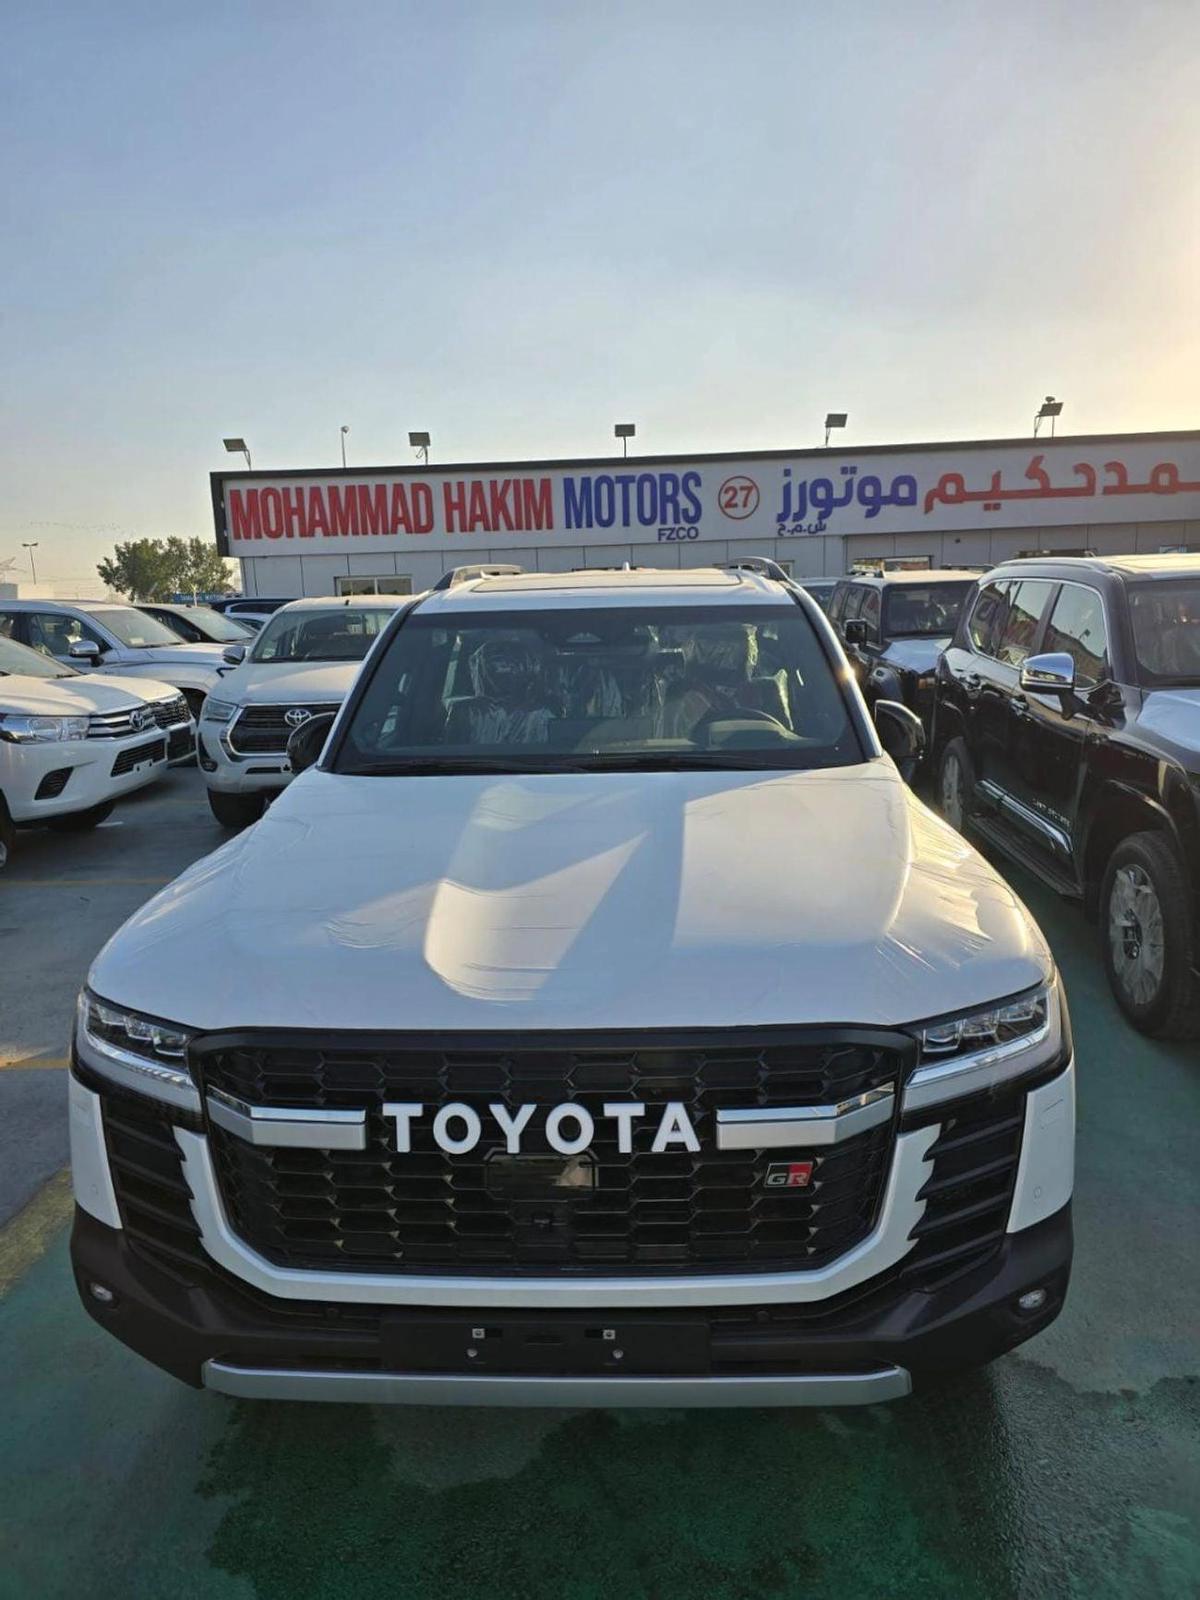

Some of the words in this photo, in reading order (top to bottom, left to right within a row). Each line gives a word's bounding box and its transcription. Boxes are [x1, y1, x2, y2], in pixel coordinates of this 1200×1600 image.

[230, 484, 434, 540] MOHAMMAD
[443, 478, 553, 532] HAKIM
[563, 472, 702, 529] MOTORS
[724, 485, 754, 508] 27
[776, 465, 918, 523] موتورز
[924, 454, 1097, 515] حكيم
[657, 526, 699, 541] FZCO
[382, 1102, 701, 1154] TOYOTA
